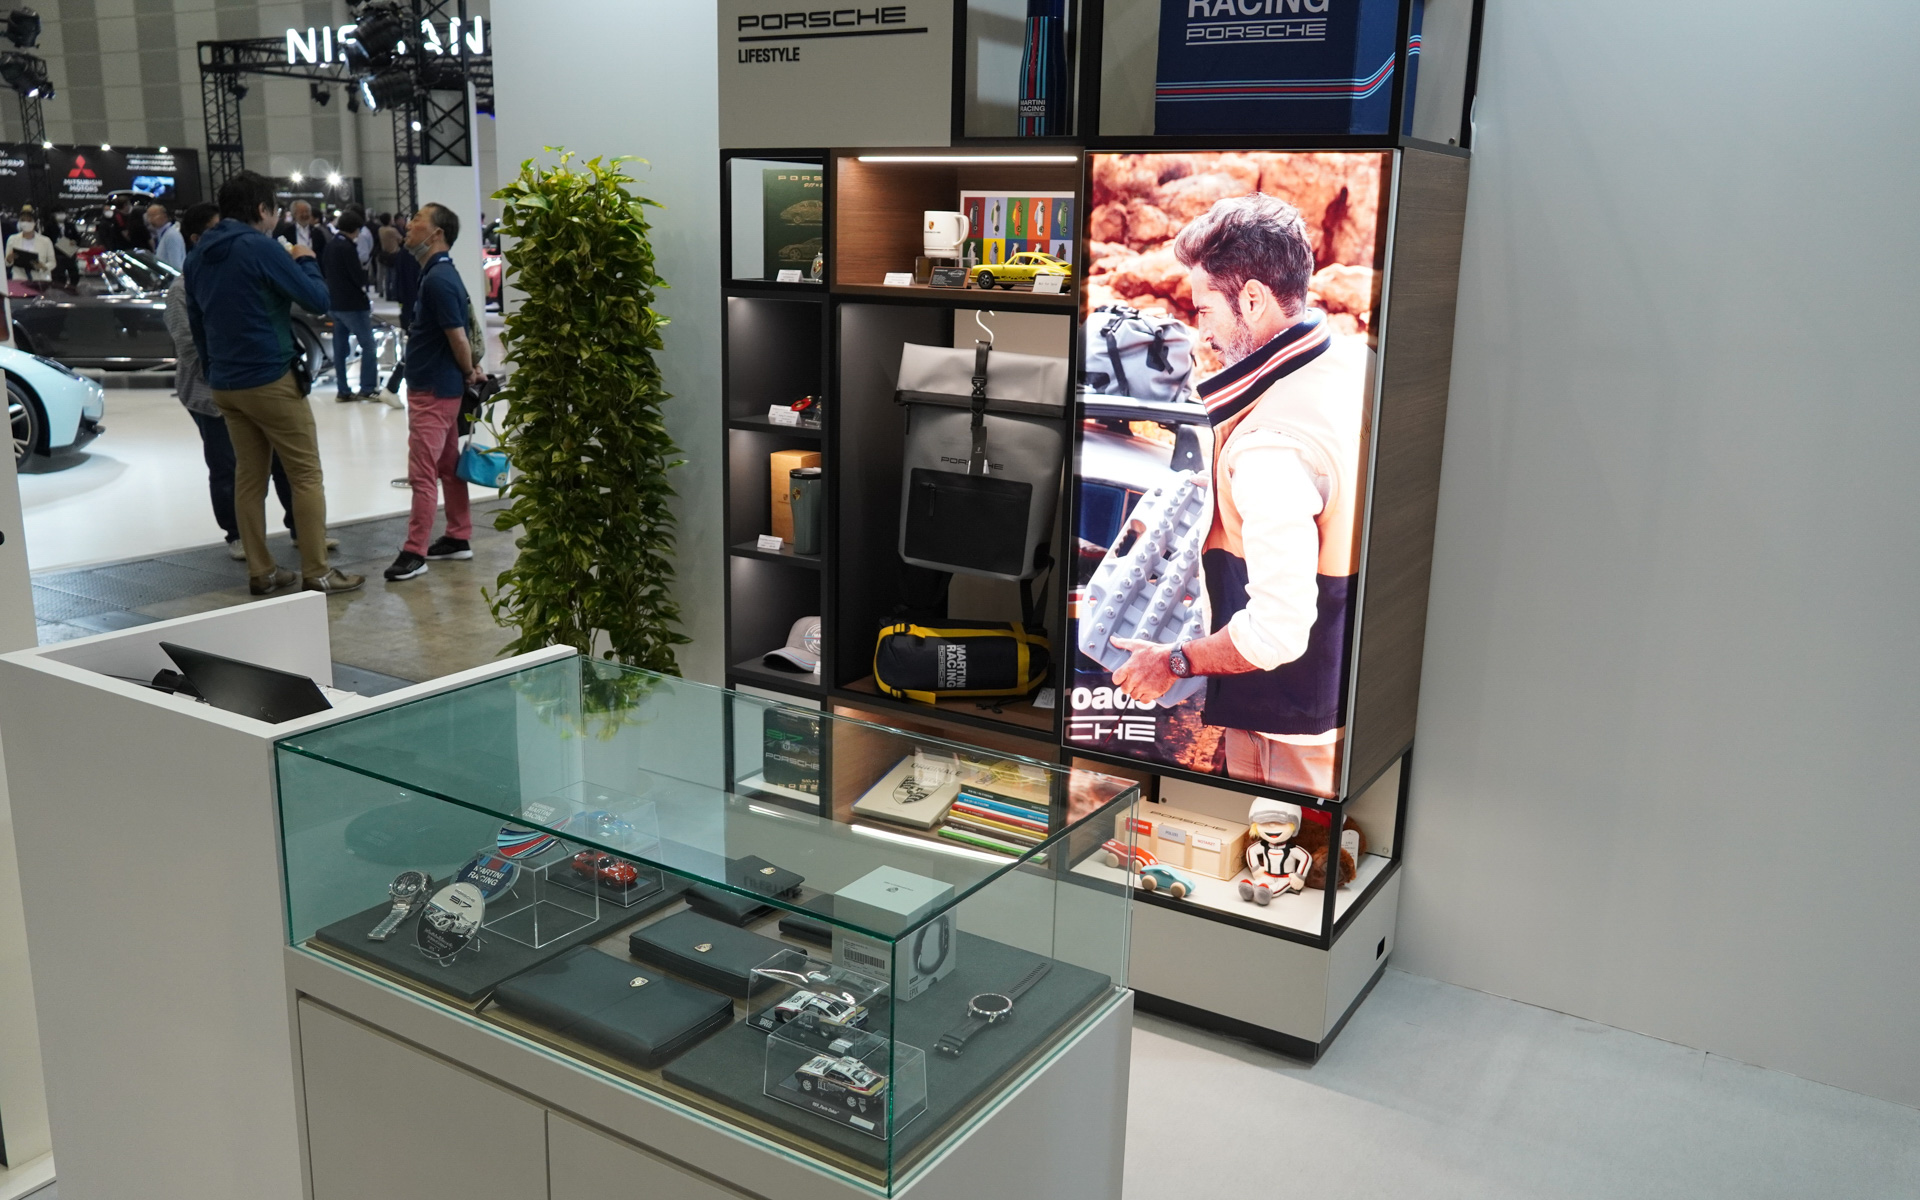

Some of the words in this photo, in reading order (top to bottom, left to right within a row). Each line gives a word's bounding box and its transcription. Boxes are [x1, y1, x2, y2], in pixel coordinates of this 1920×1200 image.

[738, 6, 906, 31] PORSCHE
[286, 15, 484, 64] NIAN
[1186, 23, 1327, 41] PORSCHE
[738, 47, 800, 63] LIFESTYLE
[63, 178, 103, 187] MITSUBISHI
[69, 185, 99, 193] MOTORS
[941, 456, 1004, 470] PORHE
[946, 645, 957, 688] RACING
[956, 645, 967, 688] MARTINI
[1065, 686, 1157, 710] oad
[765, 752, 820, 771] PORSCHE
[522, 810, 547, 822] RACING
[527, 805, 552, 817] MARTINI
[1150, 810, 1228, 832] PORSCHE
[467, 871, 499, 886] RACING
[473, 865, 505, 880] MARTINI
[449, 894, 473, 908] 917
